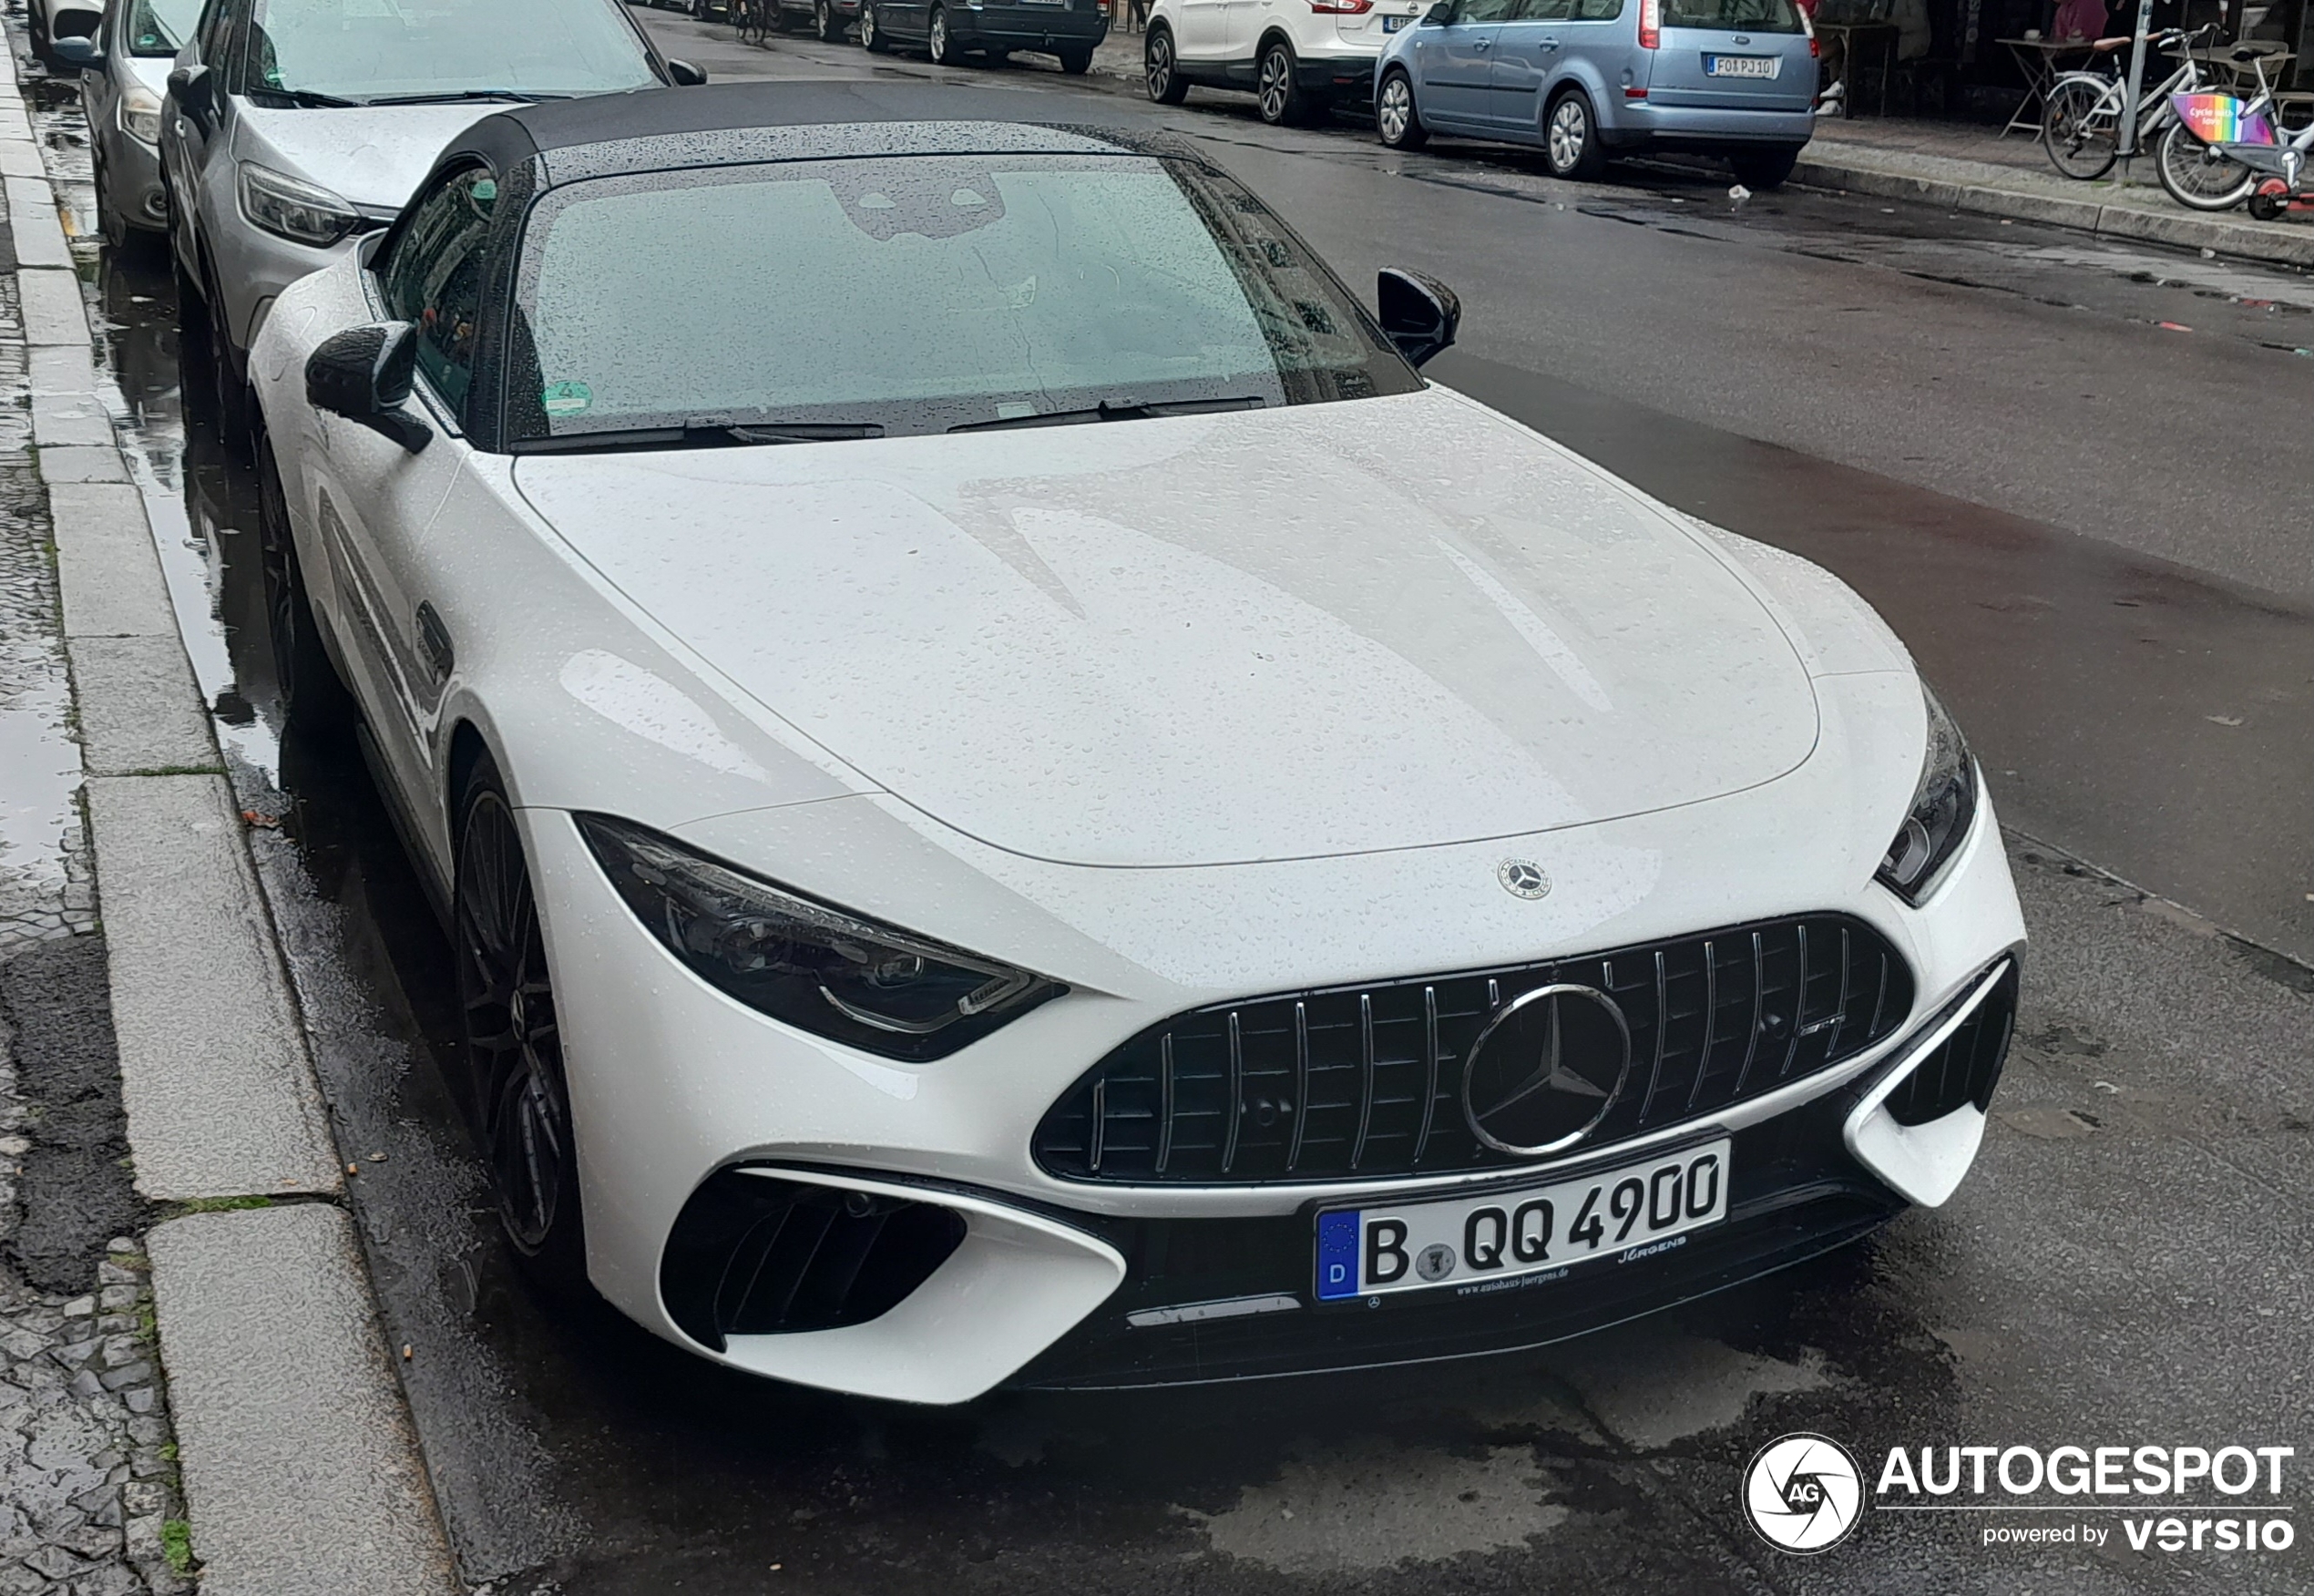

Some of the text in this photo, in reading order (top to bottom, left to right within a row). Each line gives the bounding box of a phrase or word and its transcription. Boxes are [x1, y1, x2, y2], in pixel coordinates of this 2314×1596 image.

[1717, 59, 1732, 72] FO
[2189, 107, 2235, 118] Cycle with
[1366, 1153, 1720, 1285] B QQ 4900
[1329, 1264, 1346, 1284] D
